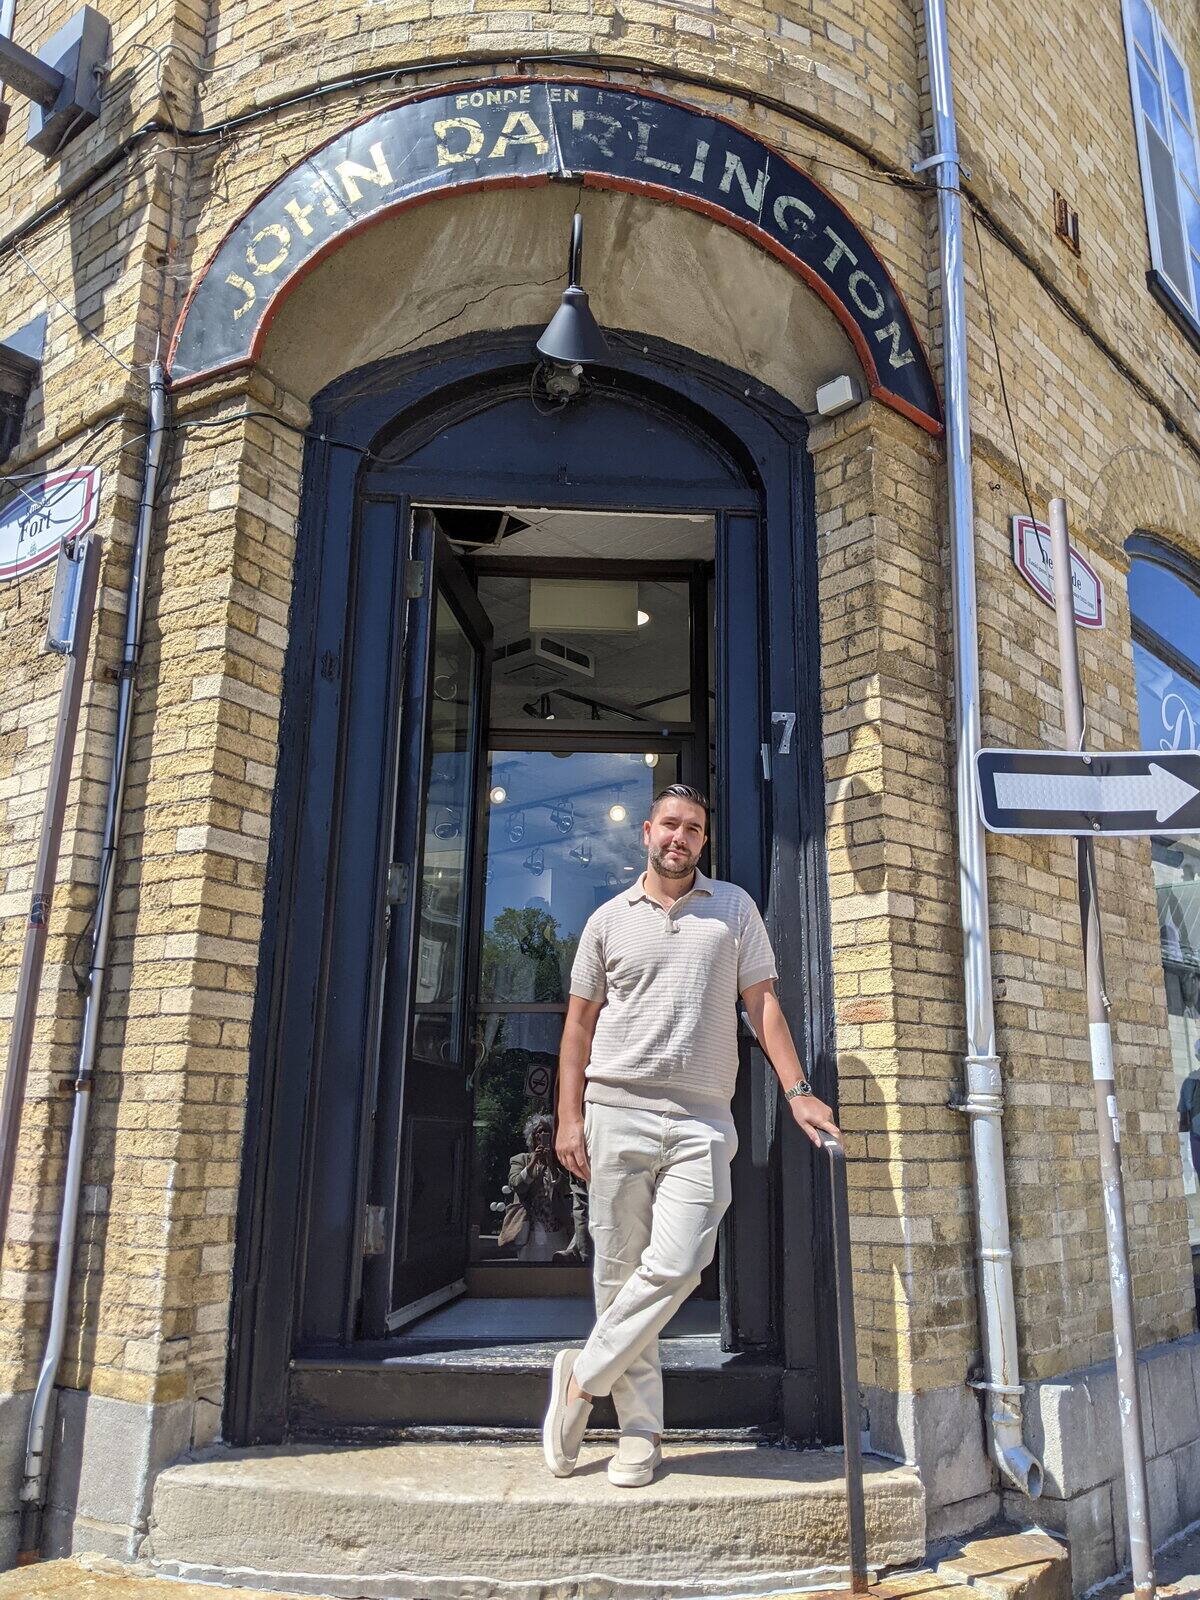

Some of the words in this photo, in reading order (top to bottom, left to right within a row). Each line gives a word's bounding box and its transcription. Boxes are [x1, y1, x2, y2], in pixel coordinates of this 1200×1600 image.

[456, 86, 531, 110] FONDÉ
[549, 88, 579, 103] EN
[225, 141, 394, 321] JOHN
[433, 110, 915, 370] DARLINGTON
[18, 509, 53, 543] Fort
[771, 711, 797, 755] 7
